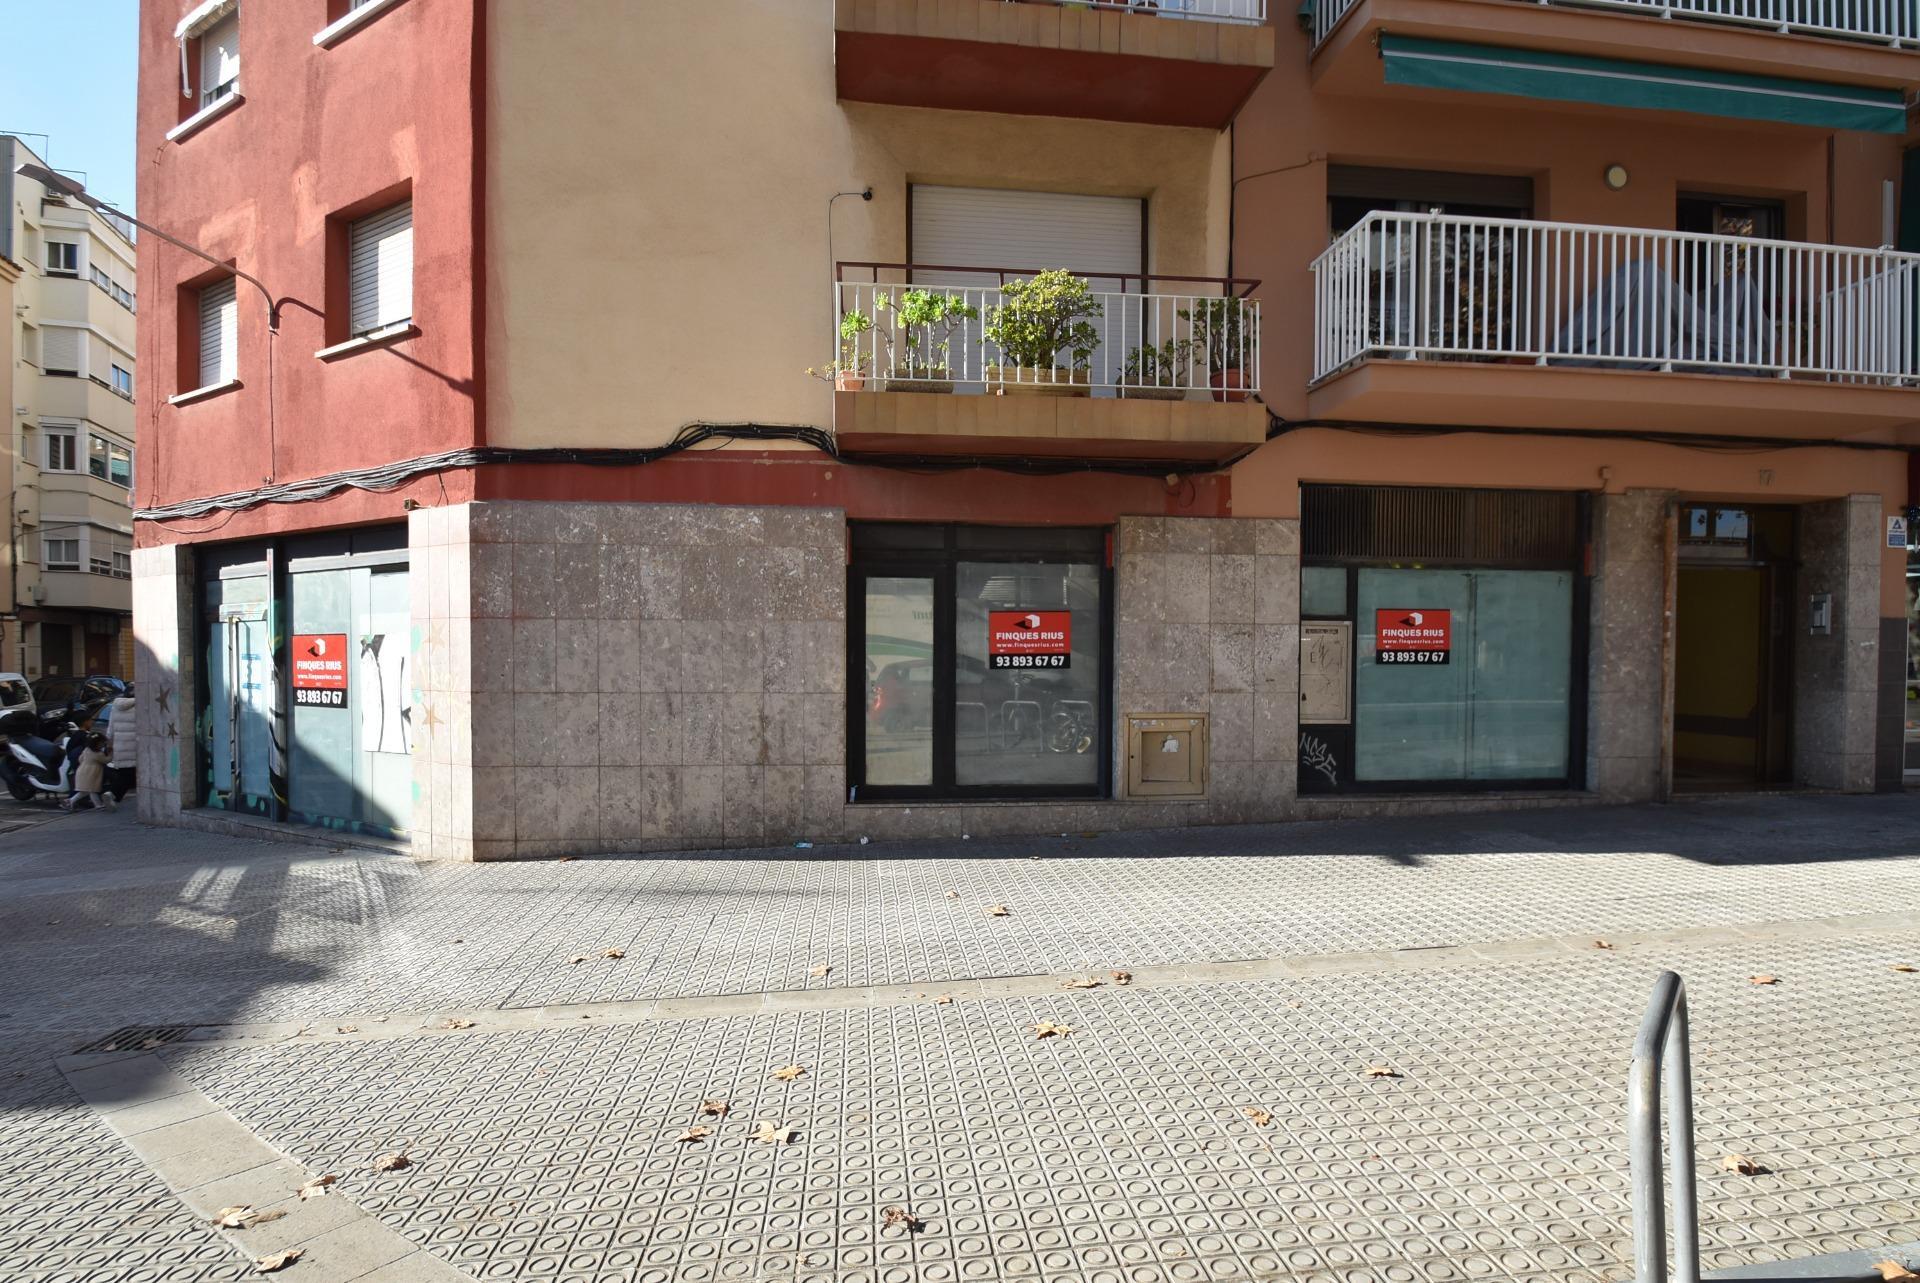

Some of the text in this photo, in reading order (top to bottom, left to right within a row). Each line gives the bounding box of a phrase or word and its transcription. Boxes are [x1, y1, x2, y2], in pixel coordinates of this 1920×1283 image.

[996, 632, 1064, 641] FINQUES RIUS
[1382, 629, 1444, 638] FINQUES RIUS
[996, 656, 1065, 667] 93 893 67 67
[1382, 652, 1444, 662] 93 893 67 67
[296, 660, 342, 671] FINQUES RIUS
[296, 689, 343, 705] 93 893 67 67
